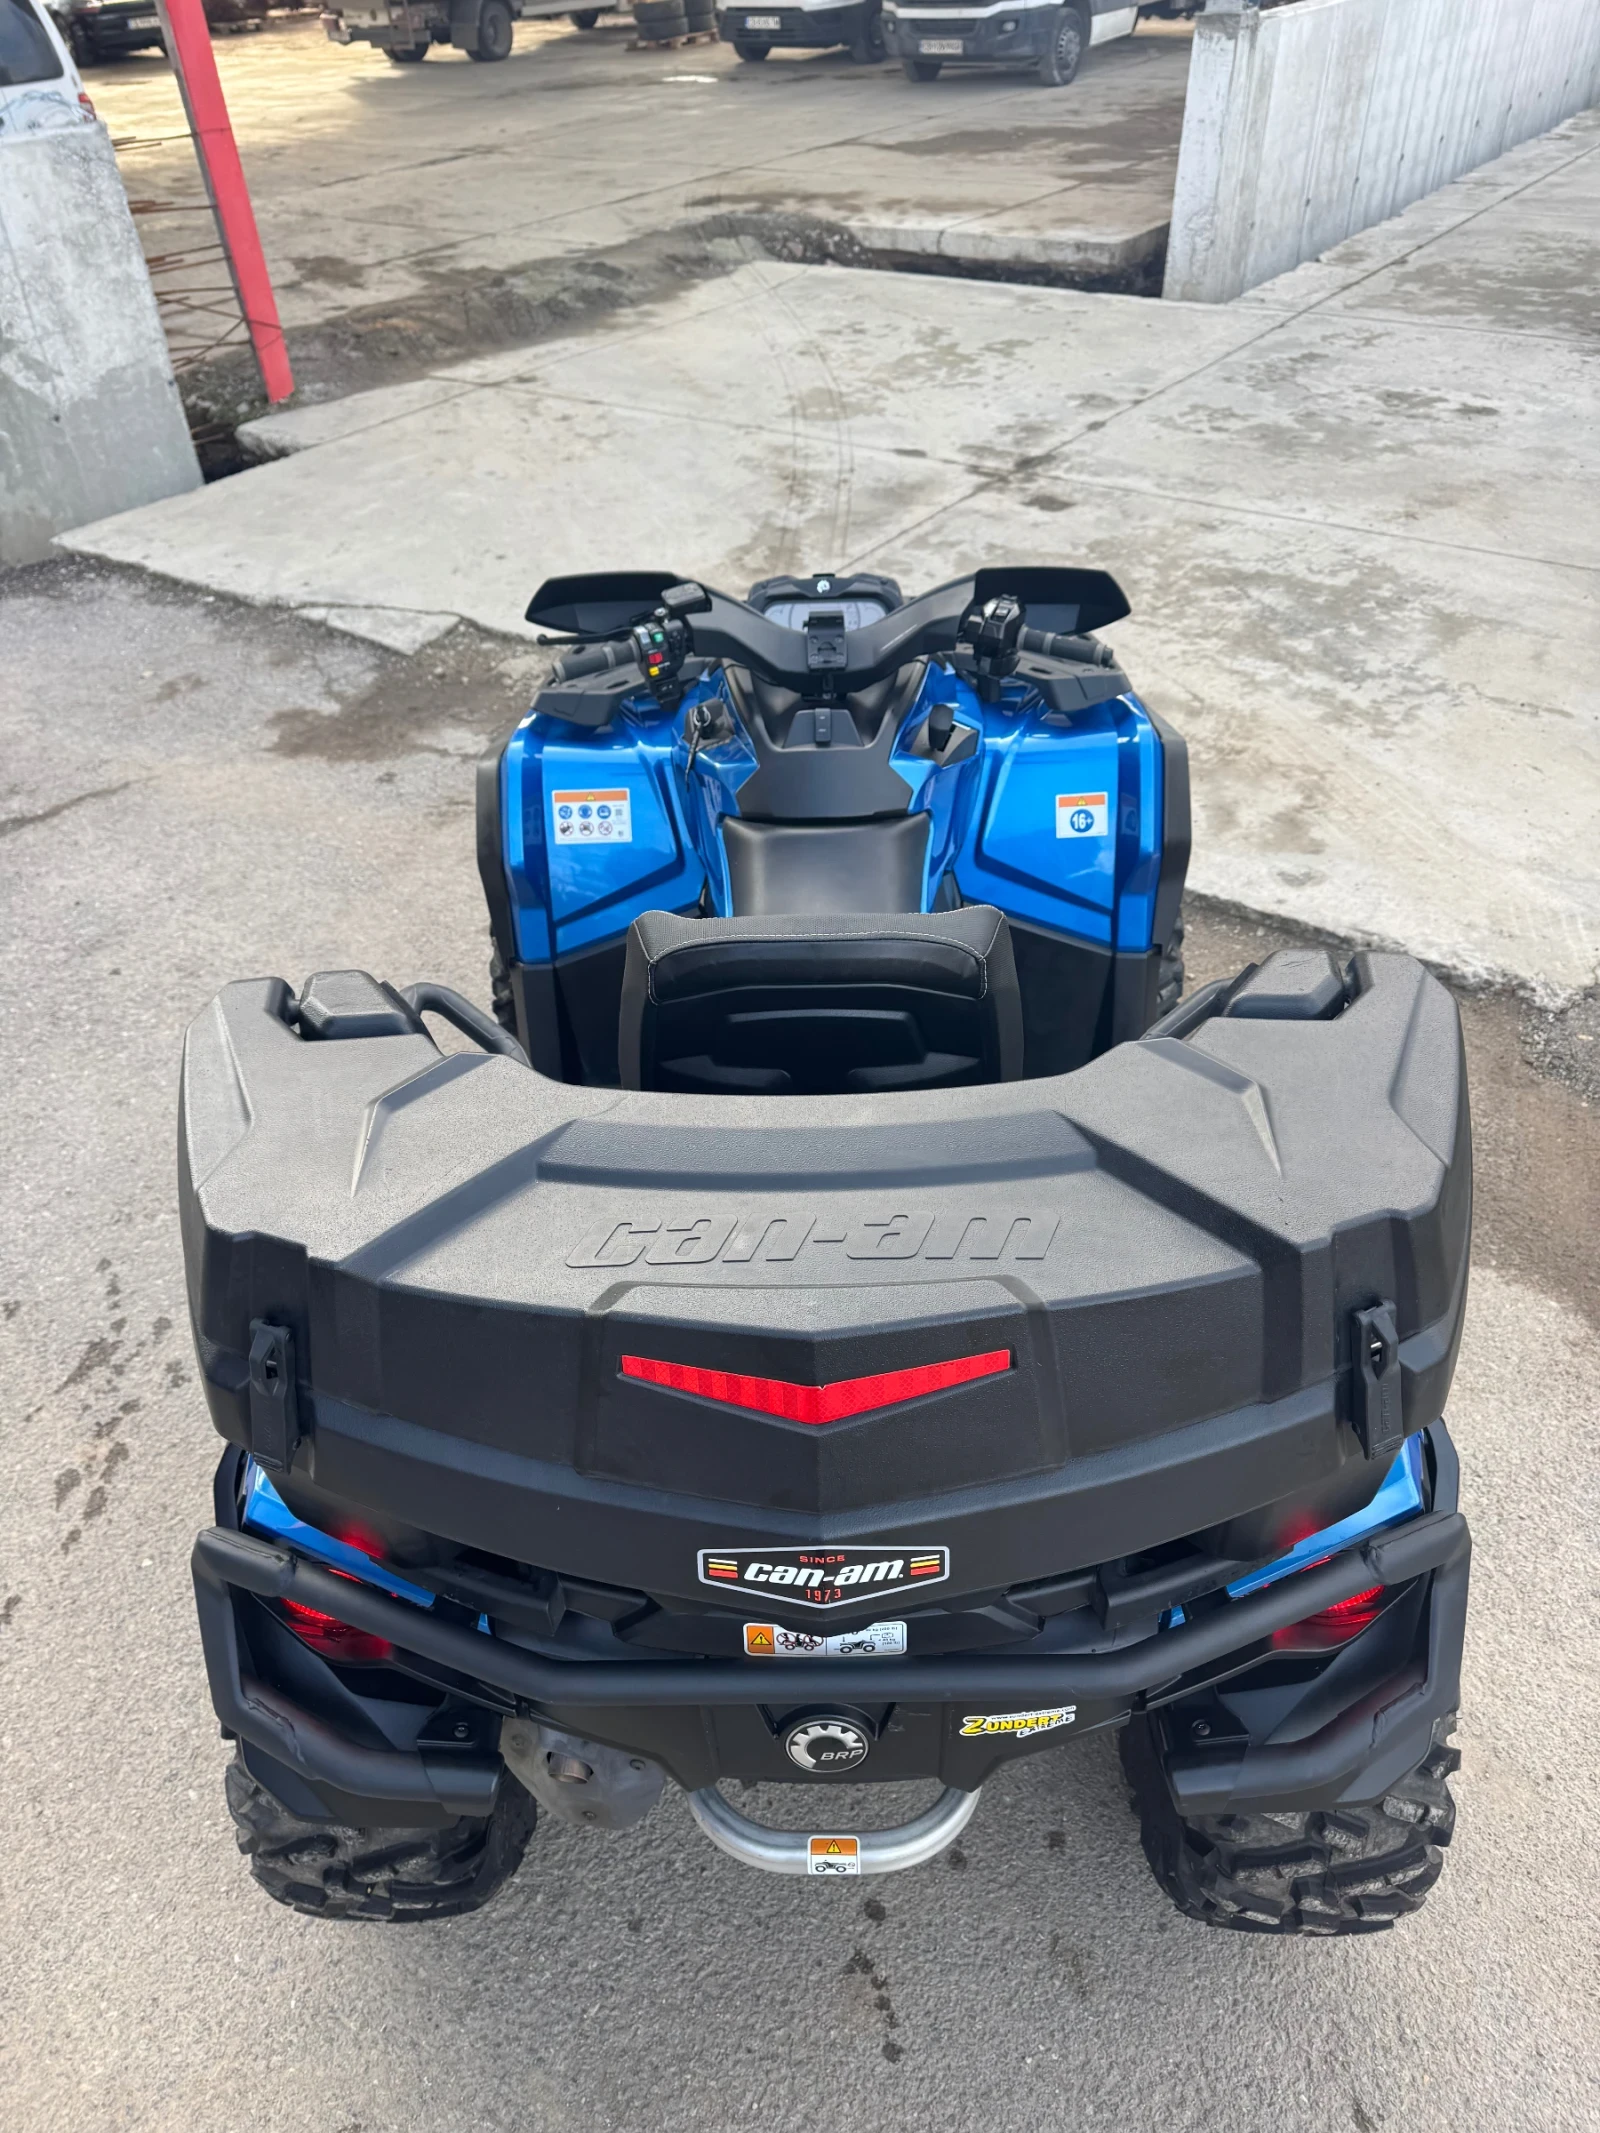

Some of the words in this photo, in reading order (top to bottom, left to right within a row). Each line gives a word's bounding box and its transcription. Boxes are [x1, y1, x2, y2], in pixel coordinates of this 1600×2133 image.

[1071, 812, 1093, 830] 16+
[564, 1210, 1062, 1268] can-am
[798, 1553, 846, 1564] SINCE
[805, 1588, 842, 1604] 1973
[962, 1713, 1064, 1735] ZUNDERT
[820, 1749, 864, 1761] BRP
